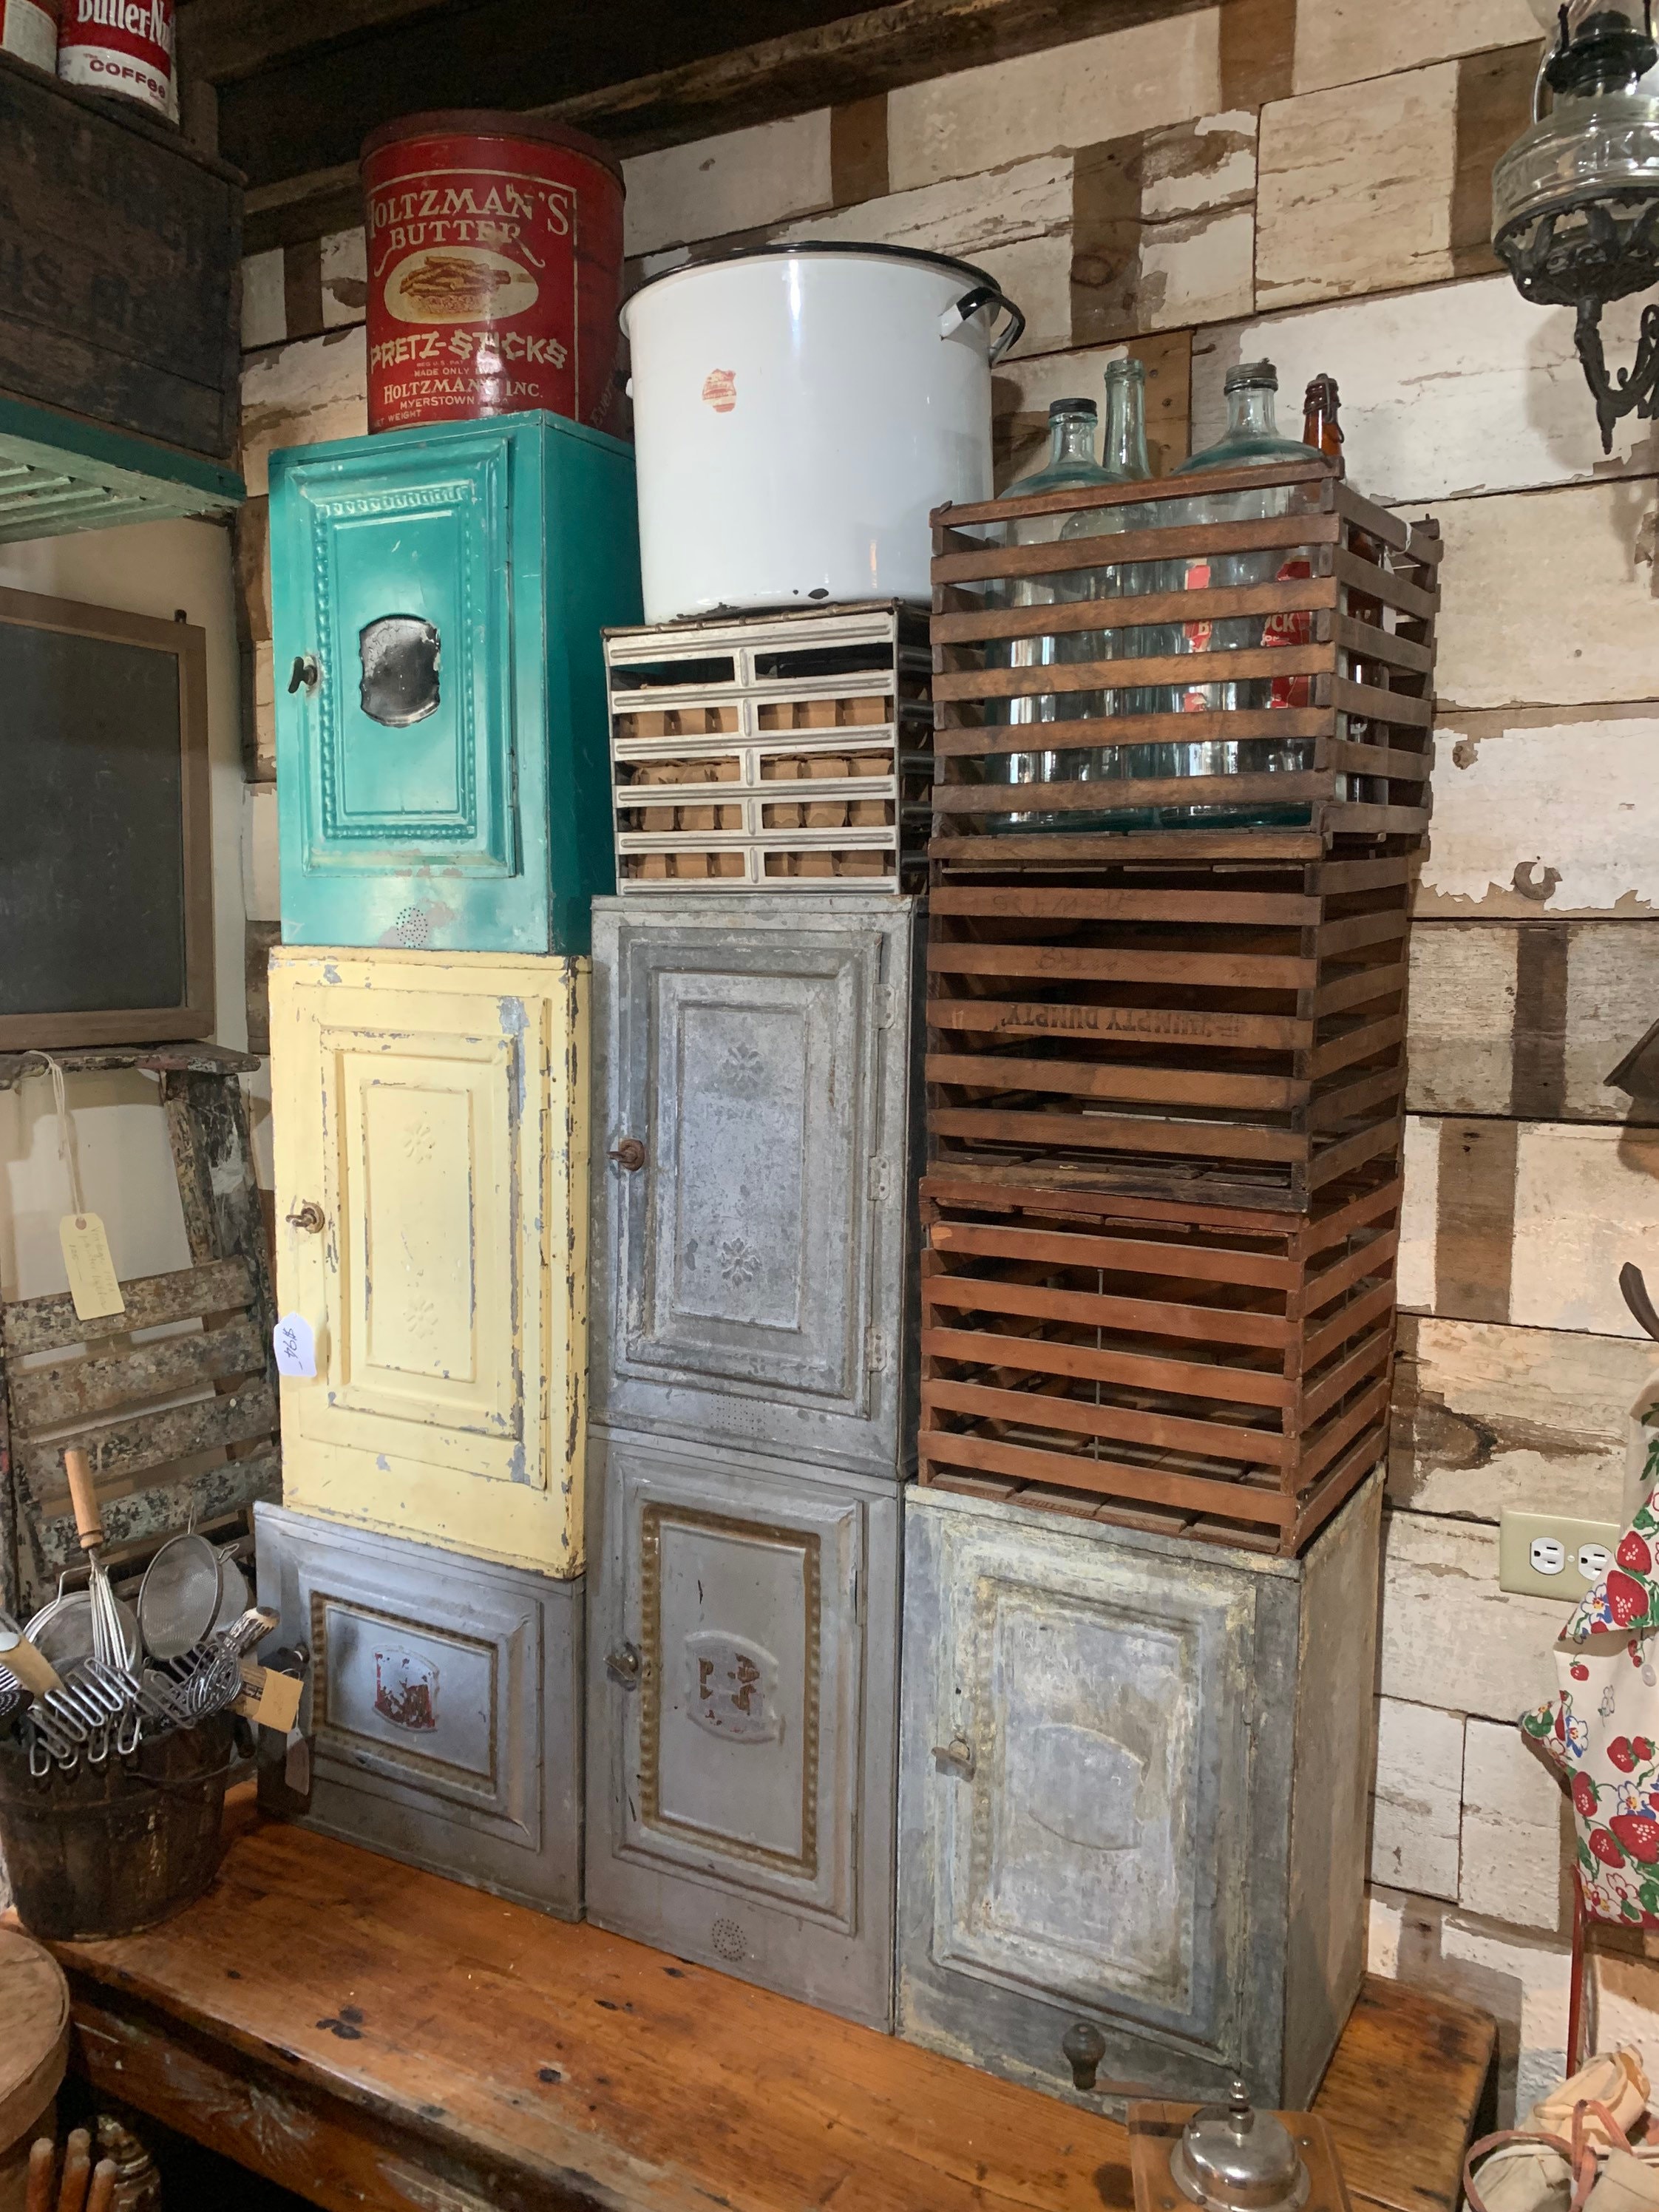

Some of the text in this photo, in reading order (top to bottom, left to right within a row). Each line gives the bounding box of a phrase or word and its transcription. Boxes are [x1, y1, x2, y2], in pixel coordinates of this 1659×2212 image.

[390, 220, 520, 249] BUTTER
[414, 369, 439, 378] MADE
[443, 366, 469, 376] ONLY
[388, 409, 421, 423] WEIGHT
